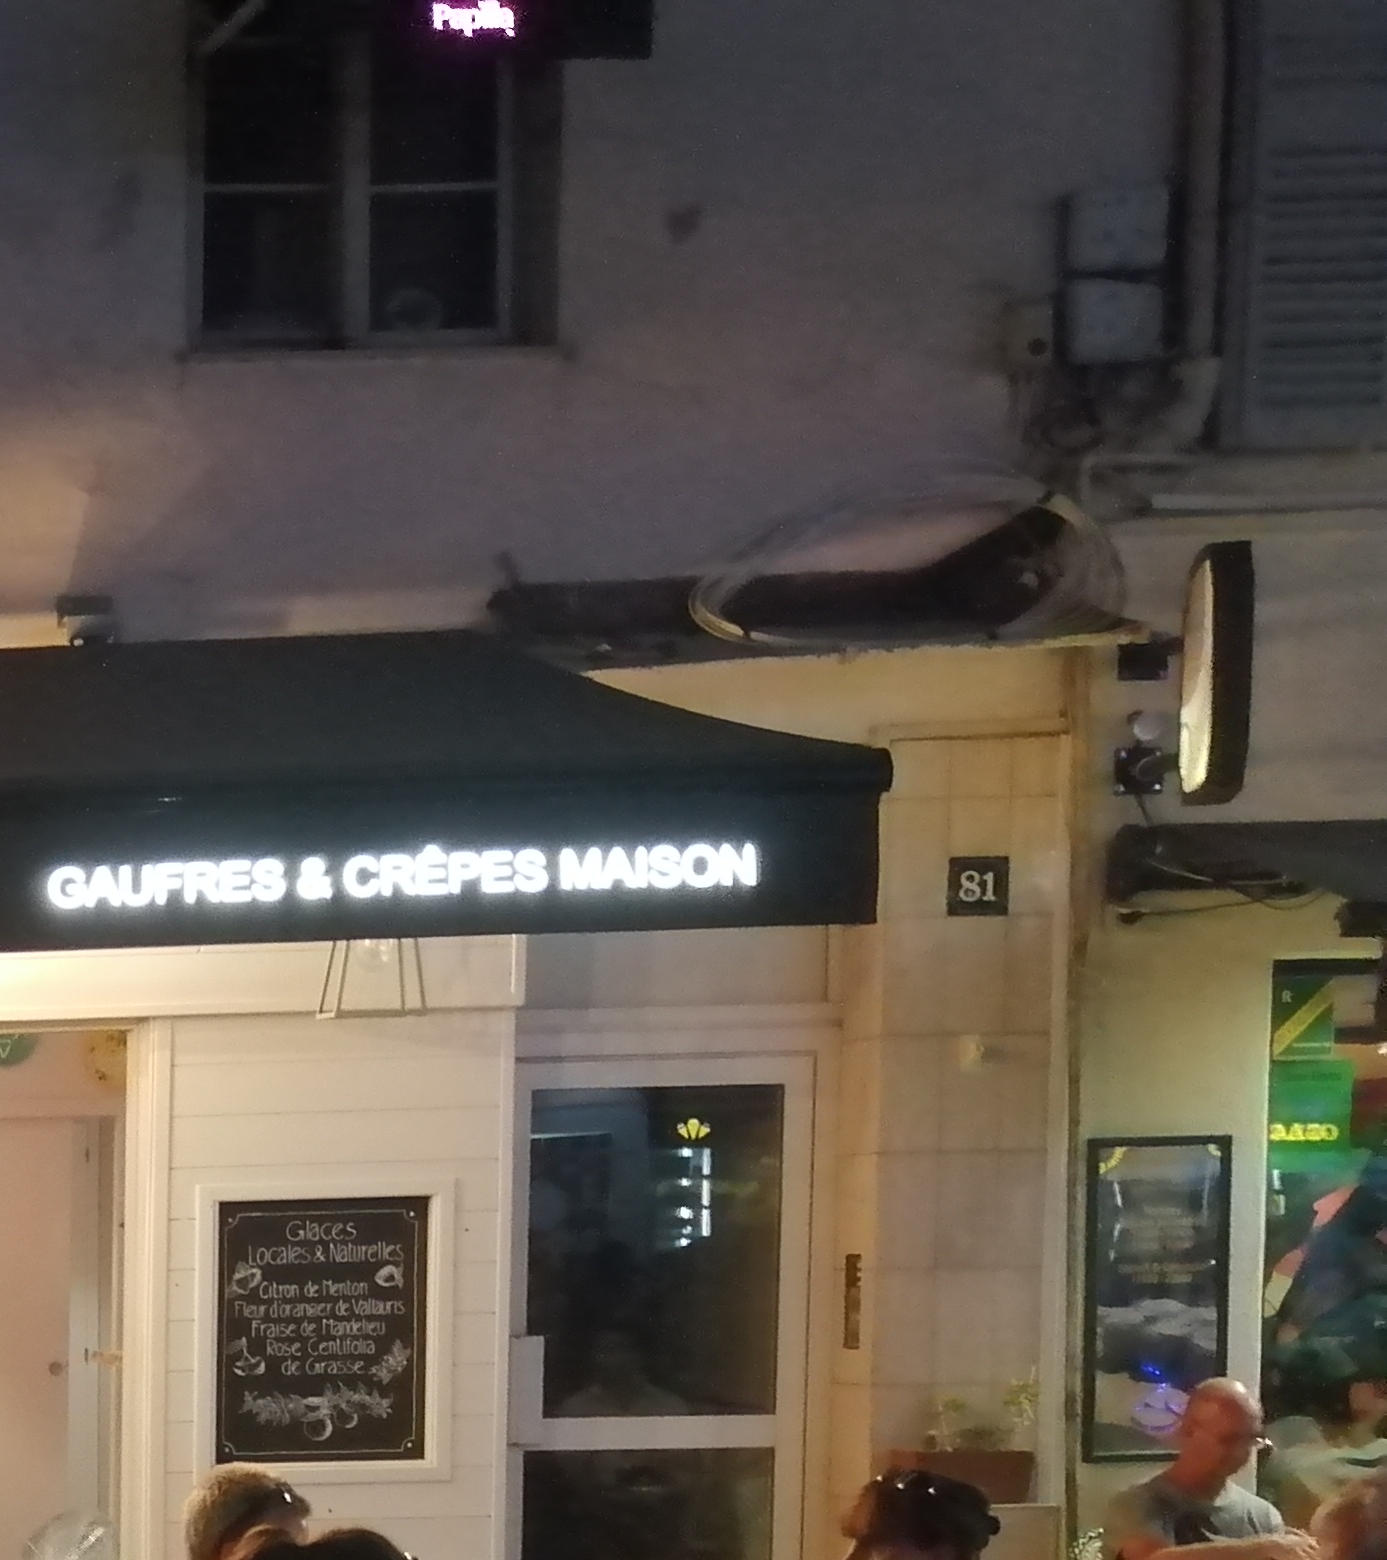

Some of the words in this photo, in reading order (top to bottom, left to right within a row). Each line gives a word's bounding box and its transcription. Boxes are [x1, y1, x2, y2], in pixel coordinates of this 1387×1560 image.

[47, 857, 286, 910] GAUFRES
[297, 856, 333, 900] &
[343, 843, 548, 899] CRÊPES
[558, 843, 759, 892] MAISON
[958, 870, 995, 902] 81
[286, 1220, 357, 1241] Glaces
[248, 1244, 310, 1266] Locales
[313, 1244, 326, 1263] &
[329, 1241, 404, 1263] Naturelles
[259, 1281, 300, 1299] Citron
[304, 1280, 318, 1297] de
[322, 1279, 368, 1297] Menton
[234, 1301, 267, 1318] Fleur
[335, 1299, 350, 1317] de
[352, 1298, 405, 1315] Vallauris
[251, 1319, 297, 1338] Fraise
[300, 1319, 317, 1336] de
[322, 1318, 386, 1336] Mandelieu
[266, 1339, 301, 1357] Rose
[308, 1337, 376, 1356] Centifolia
[281, 1358, 301, 1375] de
[305, 1358, 365, 1375] Grasse
